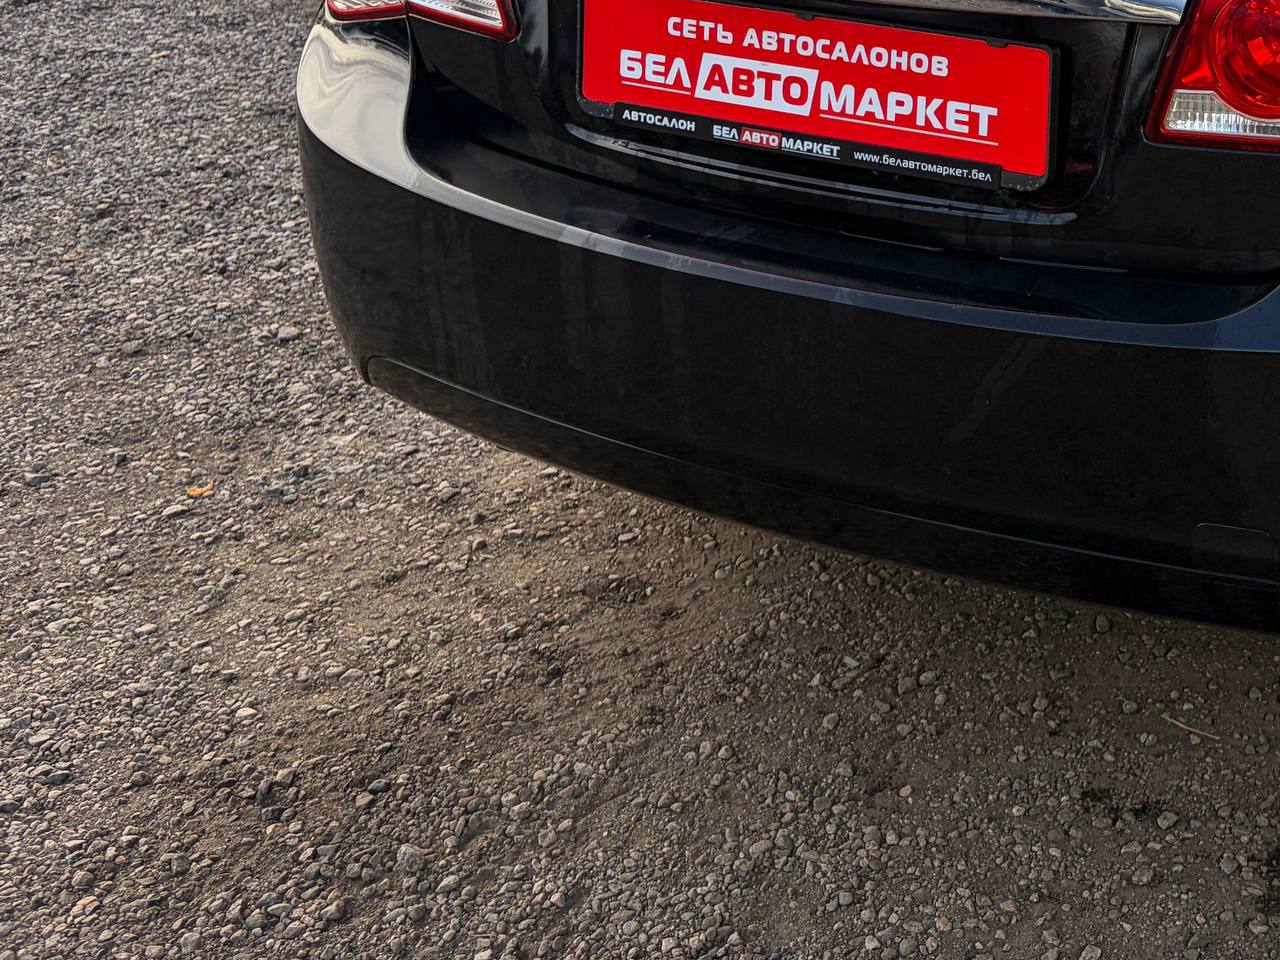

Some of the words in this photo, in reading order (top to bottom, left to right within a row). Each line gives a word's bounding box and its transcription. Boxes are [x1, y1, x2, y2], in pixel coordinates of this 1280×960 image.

[667, 16, 734, 45] СЕТЬ
[742, 28, 949, 77] АВТОСАЛОНОВ
[622, 109, 696, 132] АВТОСАЛОН
[853, 151, 992, 182] www.белавтомаркет.бел
